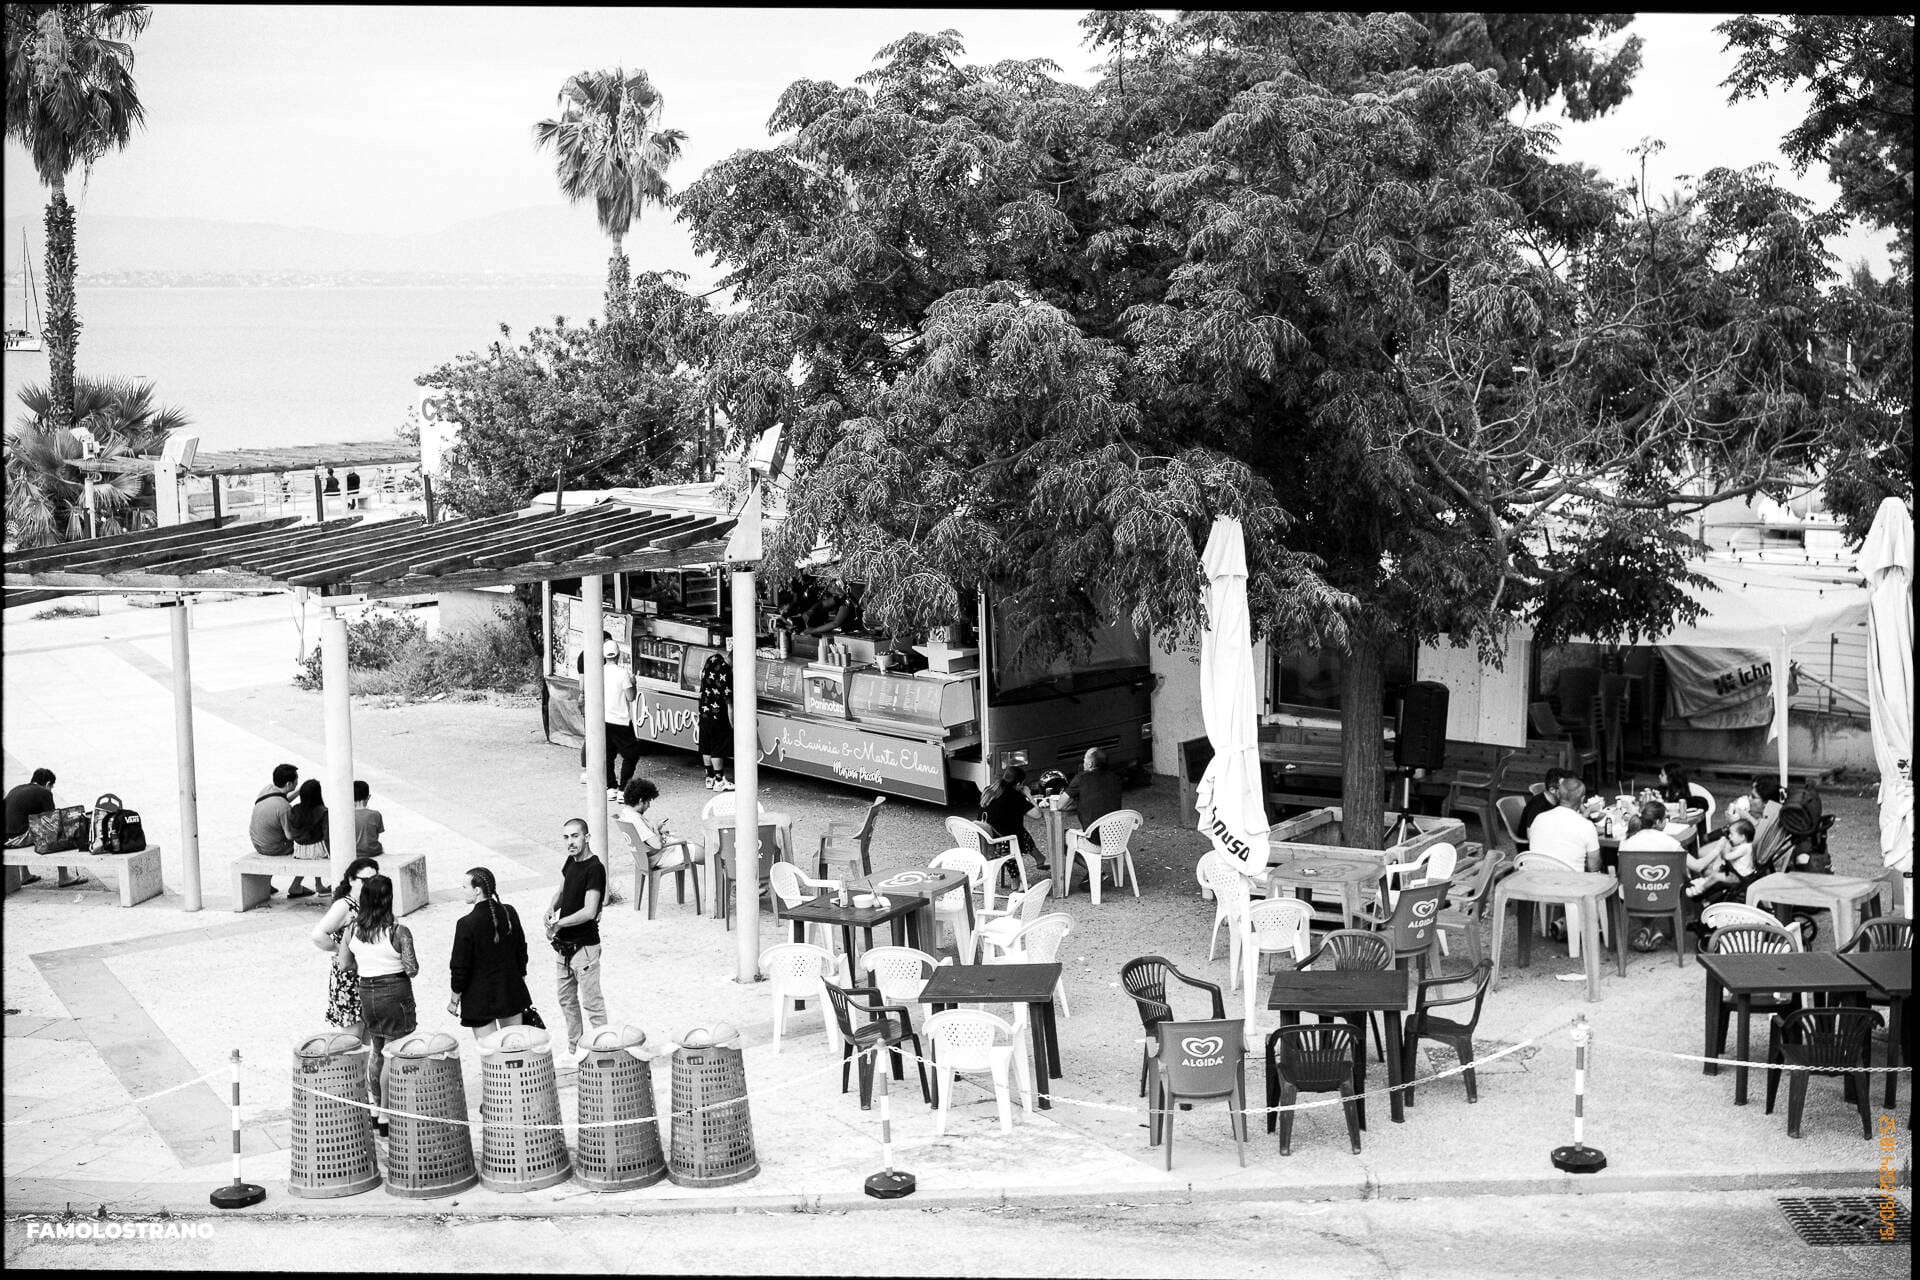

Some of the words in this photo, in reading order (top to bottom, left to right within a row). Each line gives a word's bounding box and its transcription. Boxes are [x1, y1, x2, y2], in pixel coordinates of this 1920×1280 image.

[782, 727, 793, 746] di
[794, 729, 840, 754] Lavinia
[842, 742, 853, 757] &
[853, 741, 898, 767] Marta
[899, 749, 940, 775] Elena
[1635, 882, 1670, 891] ALGIDA
[1181, 1056, 1224, 1067] ALGIDA
